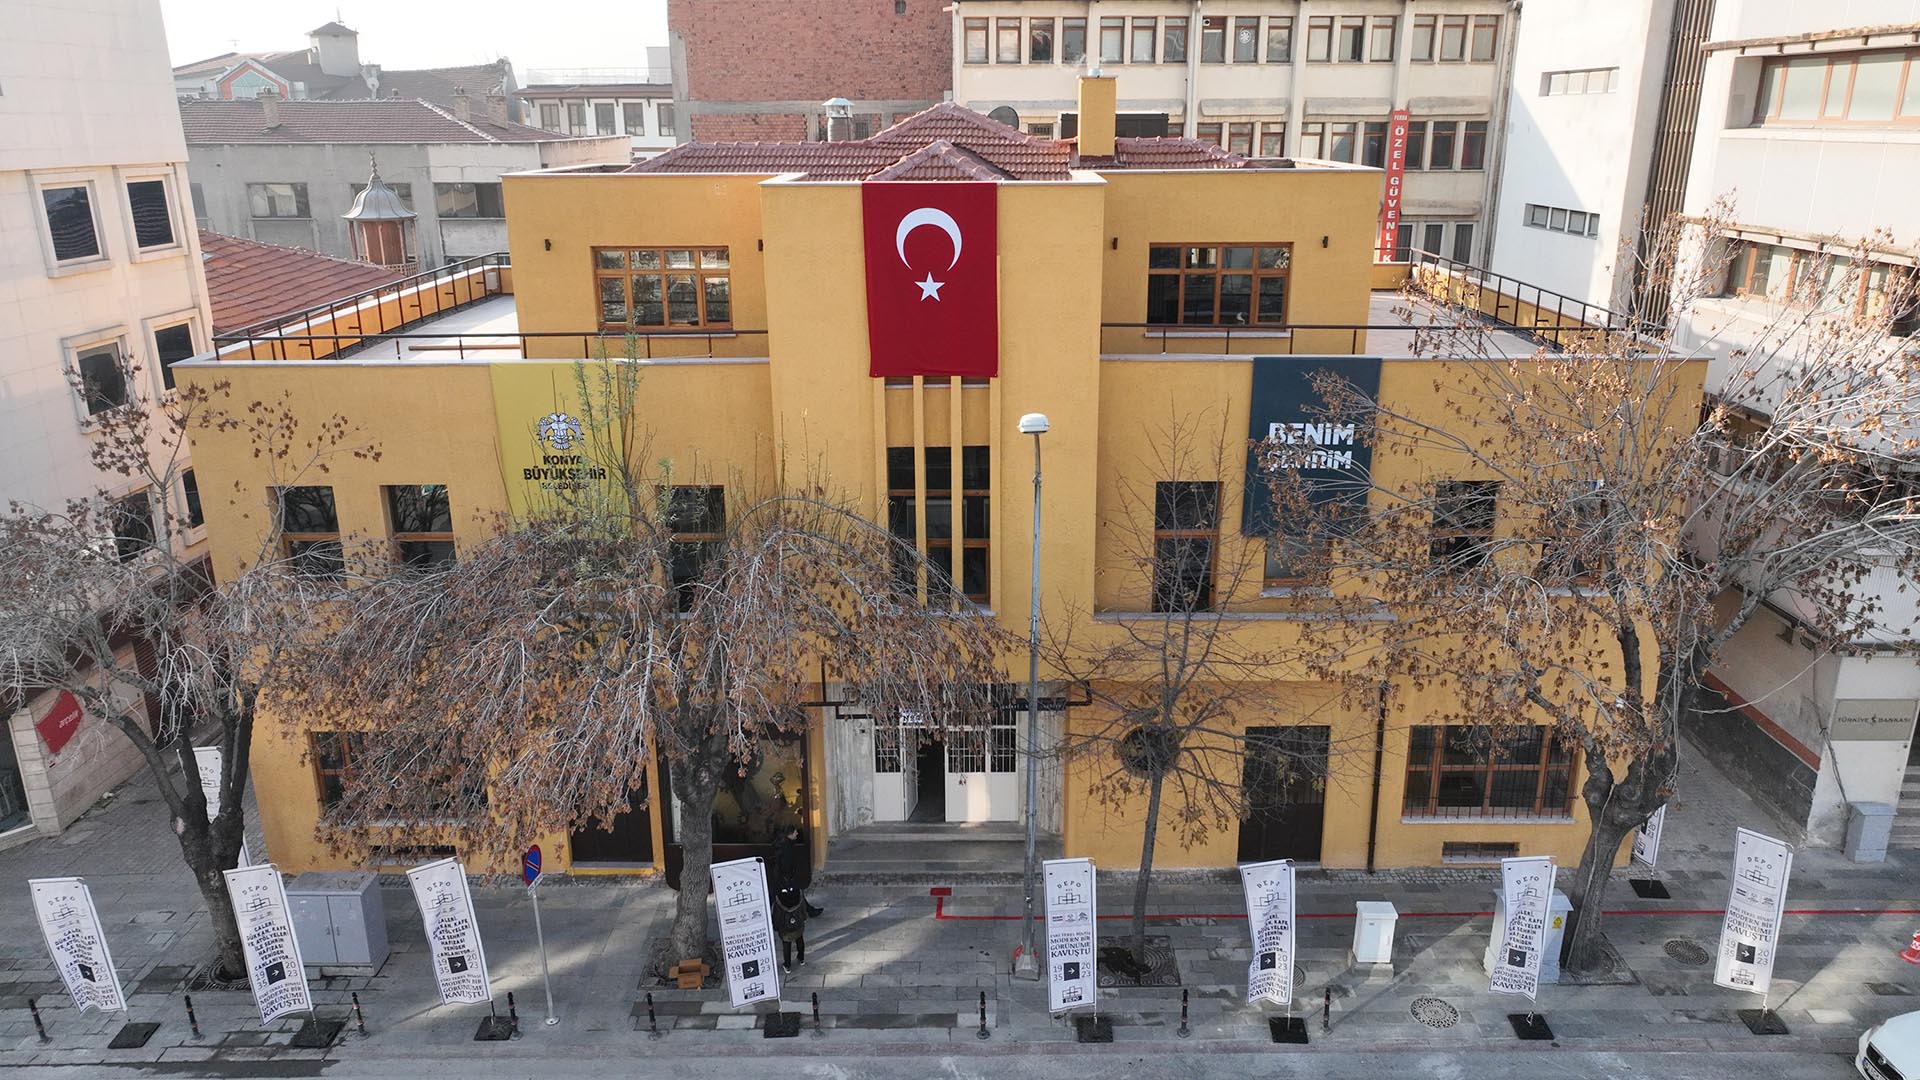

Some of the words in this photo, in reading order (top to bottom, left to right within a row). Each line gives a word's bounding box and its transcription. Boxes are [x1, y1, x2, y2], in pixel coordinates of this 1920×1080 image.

[1392, 125, 1405, 170] ÖZEL
[1382, 176, 1400, 262] GÜVENLİK
[1268, 422, 1355, 445] BENİM
[1267, 450, 1352, 471] ŞRİM
[523, 465, 606, 480] BÜYÜKŞİR
[1747, 856, 1772, 870] DEPO
[726, 880, 752, 892] DEPO
[1056, 880, 1082, 889] DEPO
[1728, 910, 1760, 926] MODERN
[1726, 924, 1772, 942] KAVUŞTU
[725, 935, 755, 946] MODERN
[1050, 936, 1079, 944] MODERN
[1726, 939, 1736, 950] 19
[728, 943, 768, 960] KAVUŞTU
[1051, 948, 1091, 958] KAVUŞTU
[1724, 947, 1736, 958] 35
[1757, 949, 1770, 958] 20
[438, 958, 448, 966] 19
[466, 953, 478, 962] 20
[760, 958, 770, 966] 20
[1278, 954, 1288, 962] 20
[1528, 953, 1539, 962] 20
[1756, 957, 1769, 966] 23
[286, 960, 296, 970] 20
[469, 961, 479, 969] 23
[731, 965, 742, 973] 19
[760, 965, 771, 974] 23
[1054, 964, 1062, 973] 19
[1081, 962, 1091, 970] 20
[1278, 962, 1288, 970] 23
[1528, 960, 1538, 970] 23
[288, 969, 298, 978] 23
[439, 966, 450, 974] 35
[1082, 970, 1091, 978] 23
[255, 971, 266, 982] 19
[732, 973, 742, 981] 35
[1054, 973, 1063, 982] 35
[256, 979, 268, 990] 35
[444, 990, 484, 1000] KAVUŞTU
[264, 998, 304, 1018] KAVUŞTU
